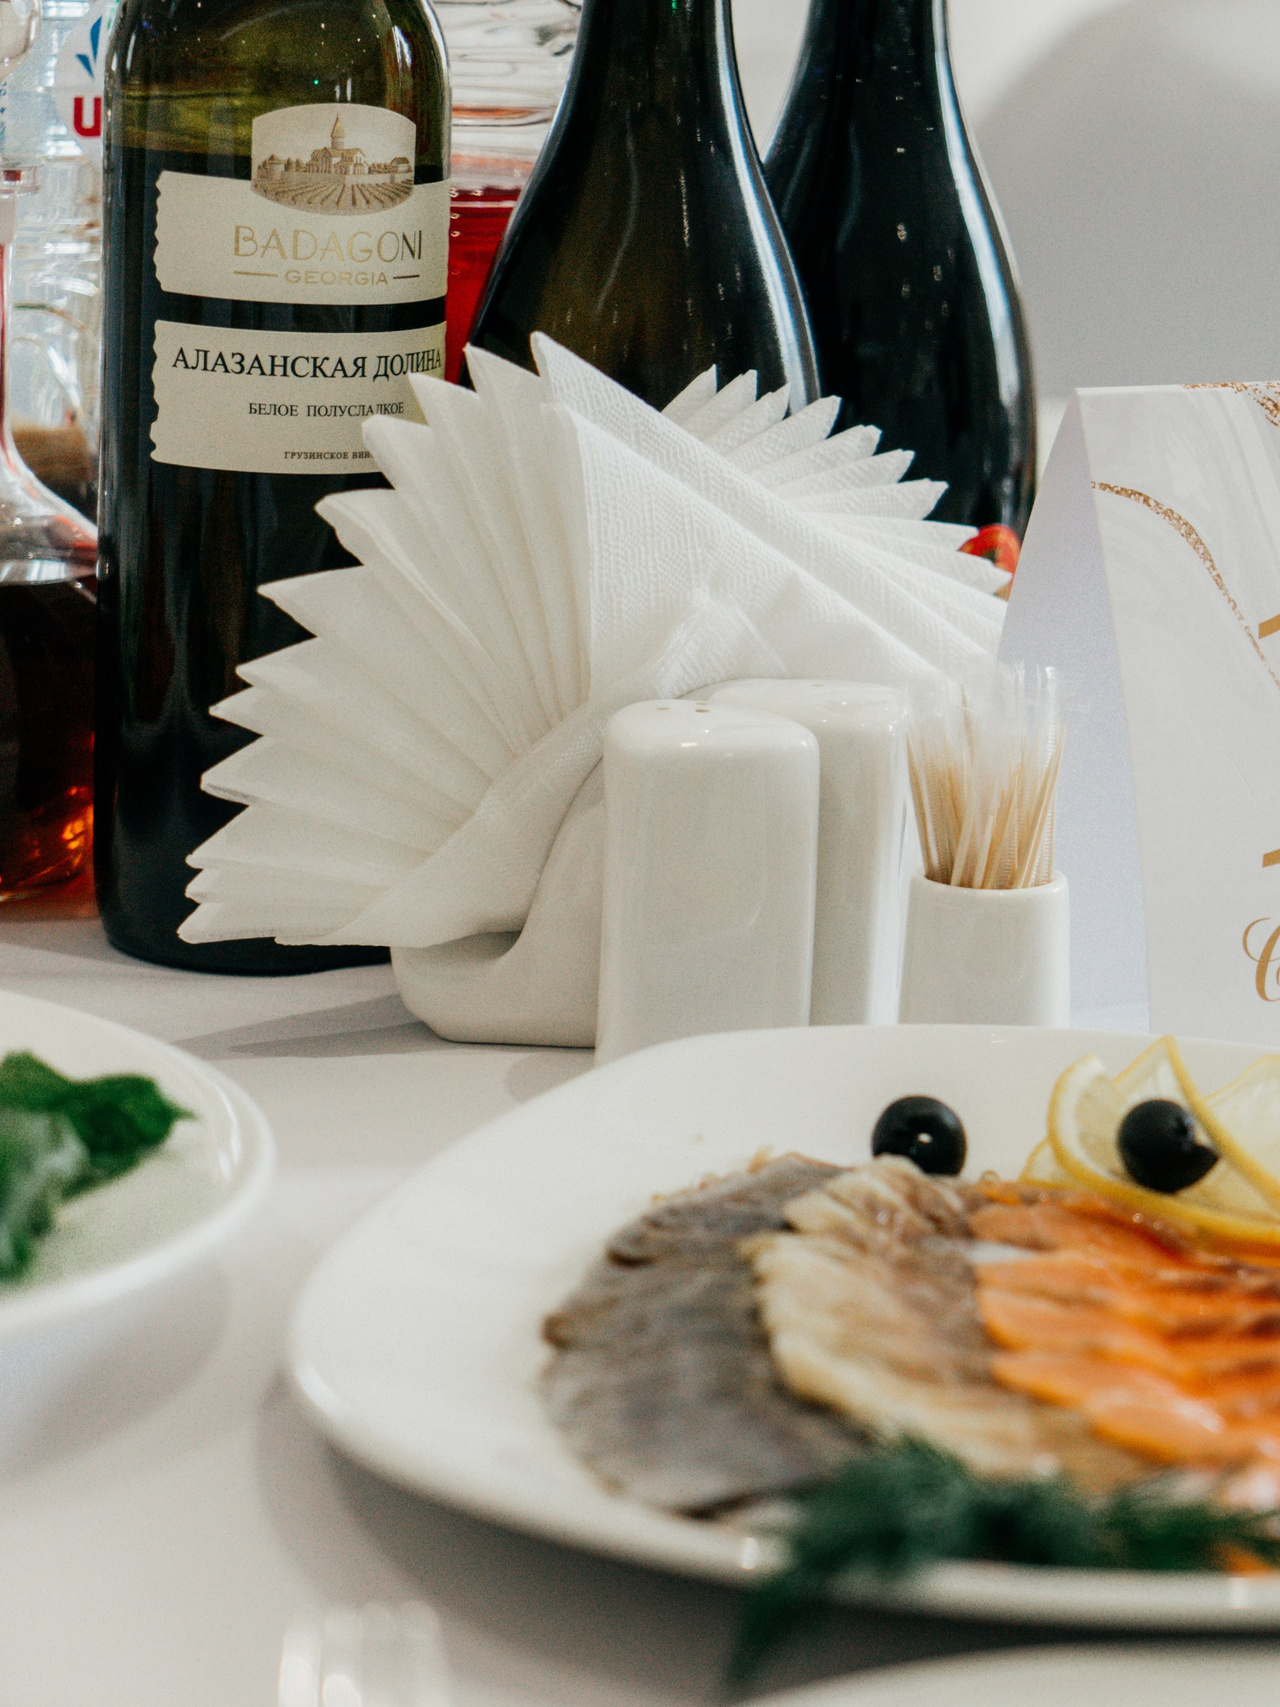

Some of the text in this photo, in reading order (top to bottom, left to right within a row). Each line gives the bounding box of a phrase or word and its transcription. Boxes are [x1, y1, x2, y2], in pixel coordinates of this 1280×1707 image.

[234, 225, 422, 263] BADAGONI
[284, 269, 389, 286] GEORGIA
[172, 346, 442, 382] АЛАЗАНСКАЯ ДОЛИНА
[248, 402, 405, 417] БЕЛОЕ ПОЛУСЛАДКОЕ
[284, 451, 349, 460] ГРУЗИНСКОЕ
